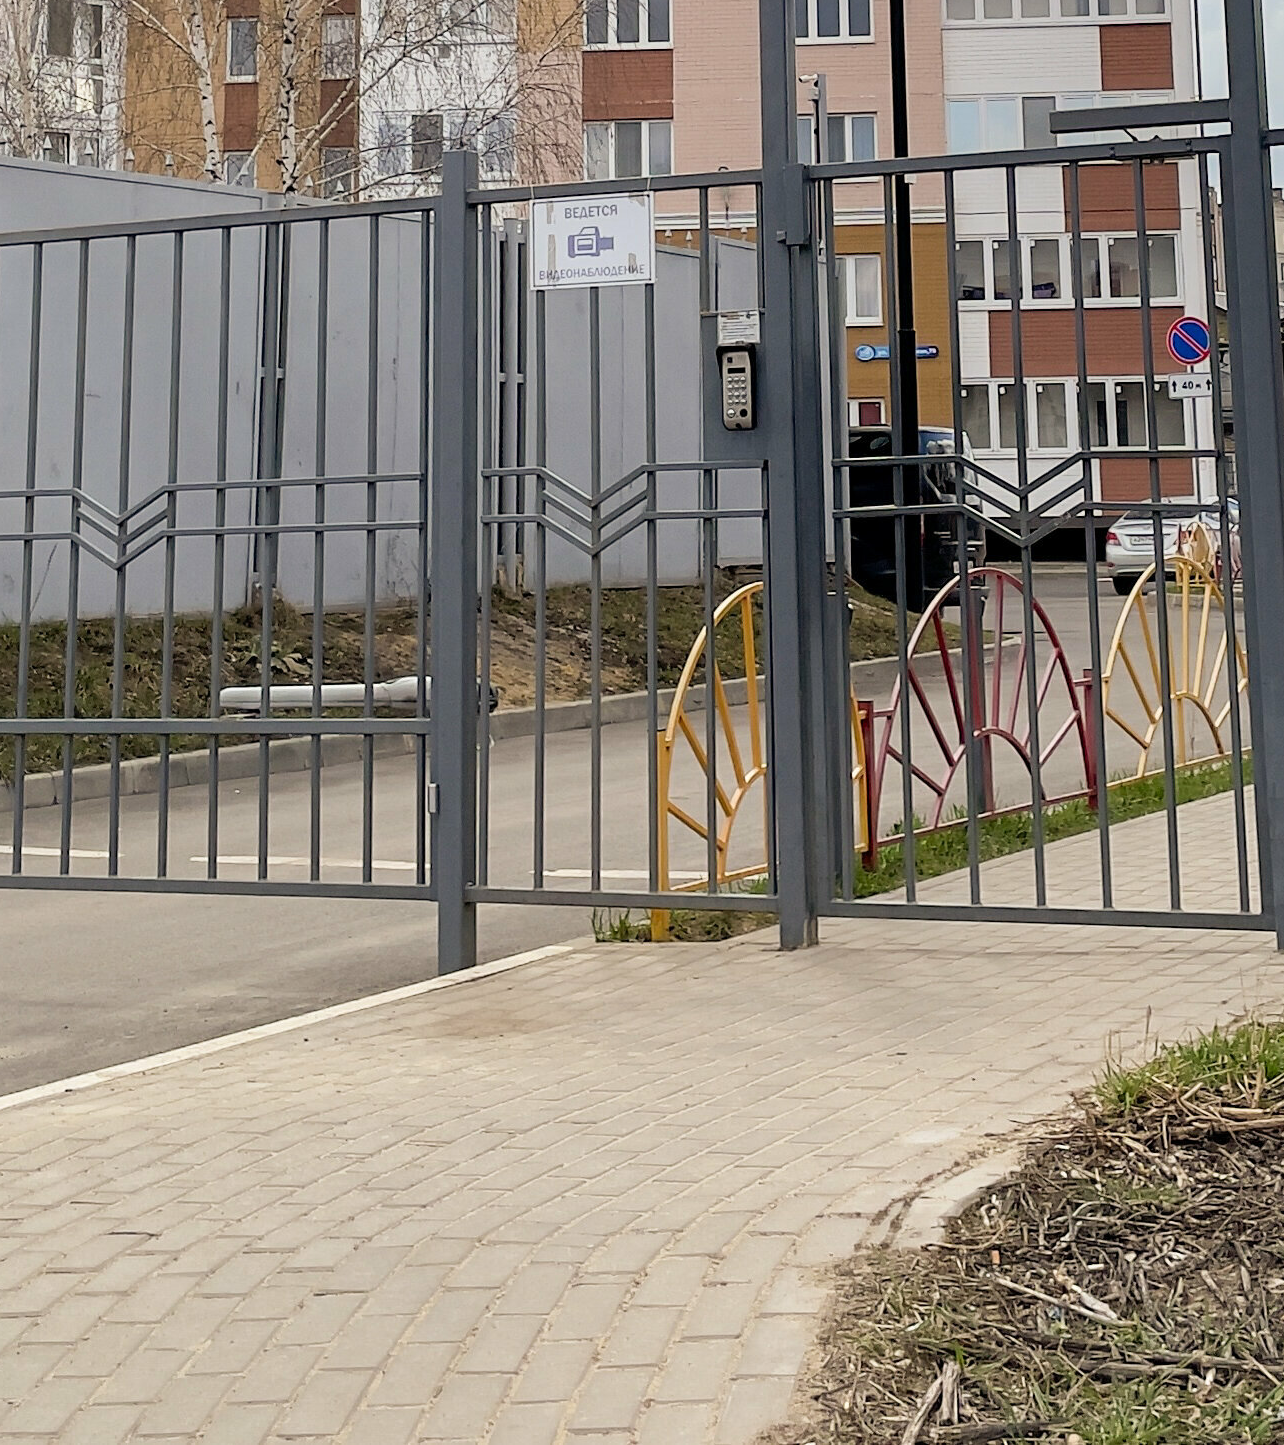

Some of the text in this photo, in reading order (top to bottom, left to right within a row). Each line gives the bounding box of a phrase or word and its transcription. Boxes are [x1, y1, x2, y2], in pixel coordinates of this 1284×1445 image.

[564, 204, 618, 219] ВЕДЕТСЯ
[539, 264, 645, 281] ВИДЕОНАБЛЮДЕНИЕ
[1182, 381, 1193, 389] 40
